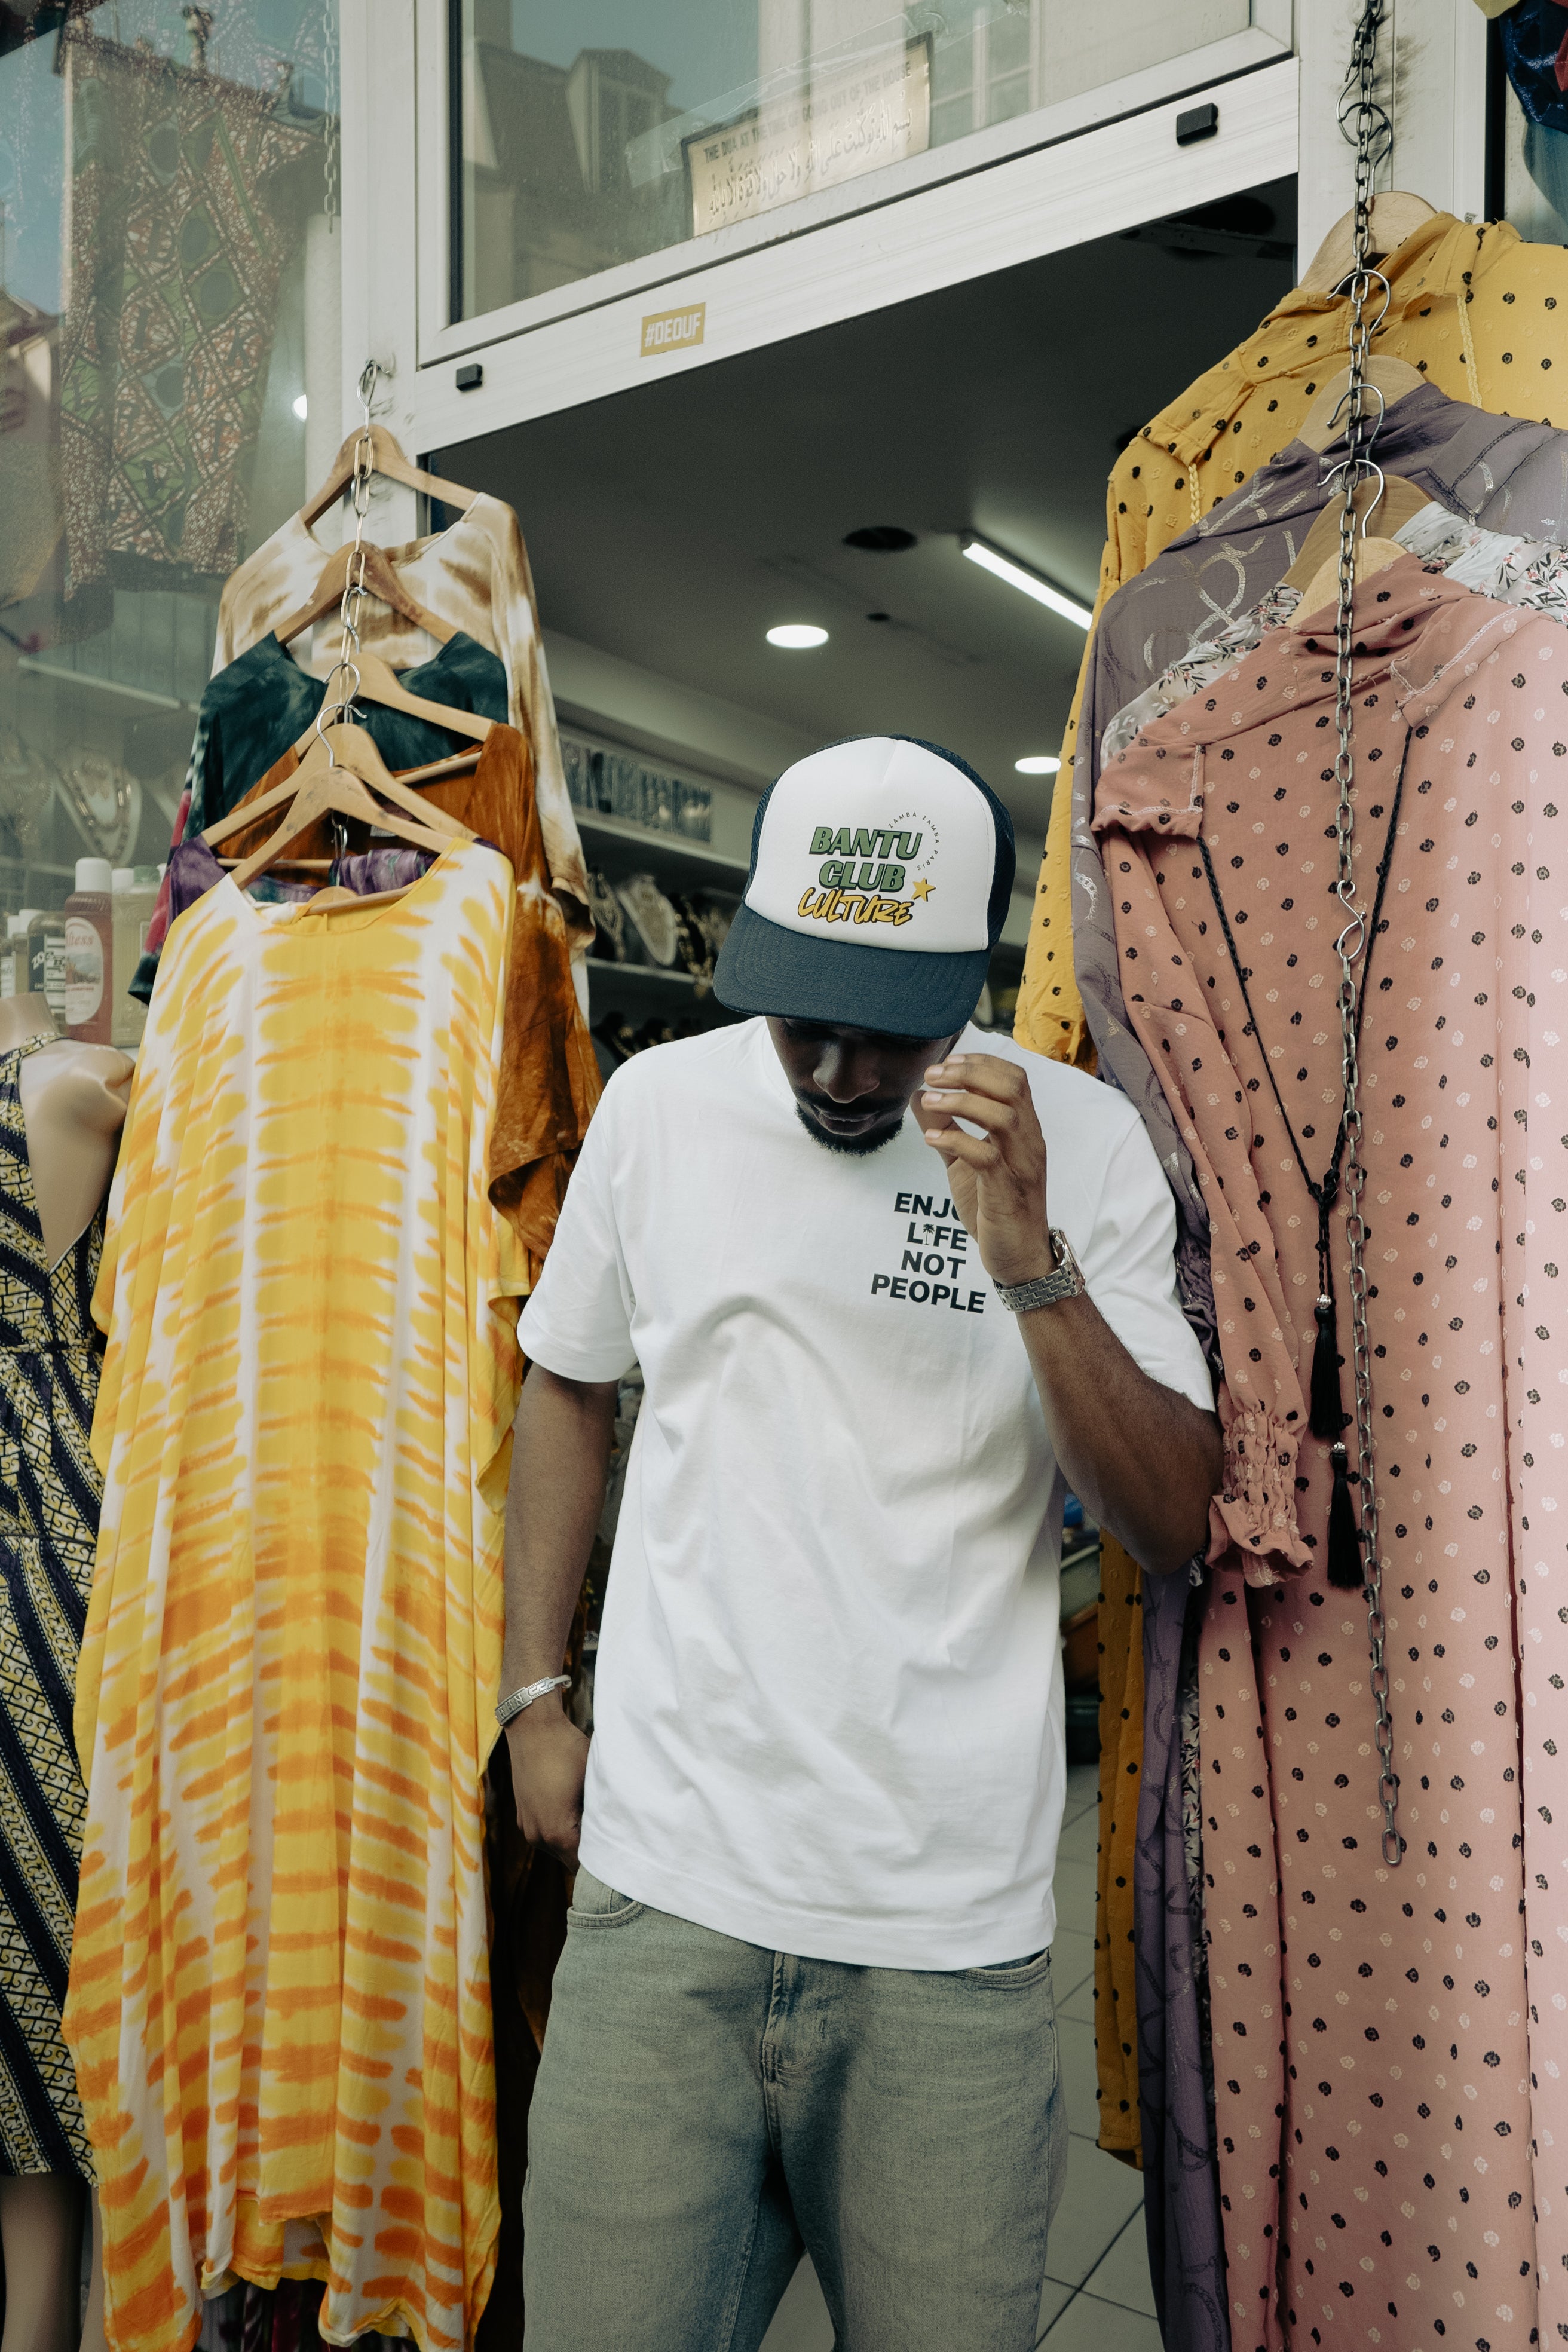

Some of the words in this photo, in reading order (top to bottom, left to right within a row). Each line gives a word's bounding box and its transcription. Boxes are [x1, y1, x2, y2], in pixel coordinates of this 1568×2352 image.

[703, 143, 719, 164] THE
[739, 130, 749, 149] AT
[830, 88, 846, 110] OUT
[849, 82, 860, 102] OF
[863, 74, 880, 96] THE
[883, 59, 911, 87] HOUSE
[644, 312, 702, 347] #DEOUF
[888, 812, 917, 828] ZAMBA
[922, 815, 939, 844] ZAMBA
[809, 826, 923, 860] BANTU
[819, 860, 906, 892] CLUB
[917, 850, 938, 871] PARIS
[797, 887, 914, 926] CULTURE
[894, 1192, 961, 1221] ENJ
[901, 1250, 966, 1279] NOT
[871, 1273, 987, 1313] PEOPLE
